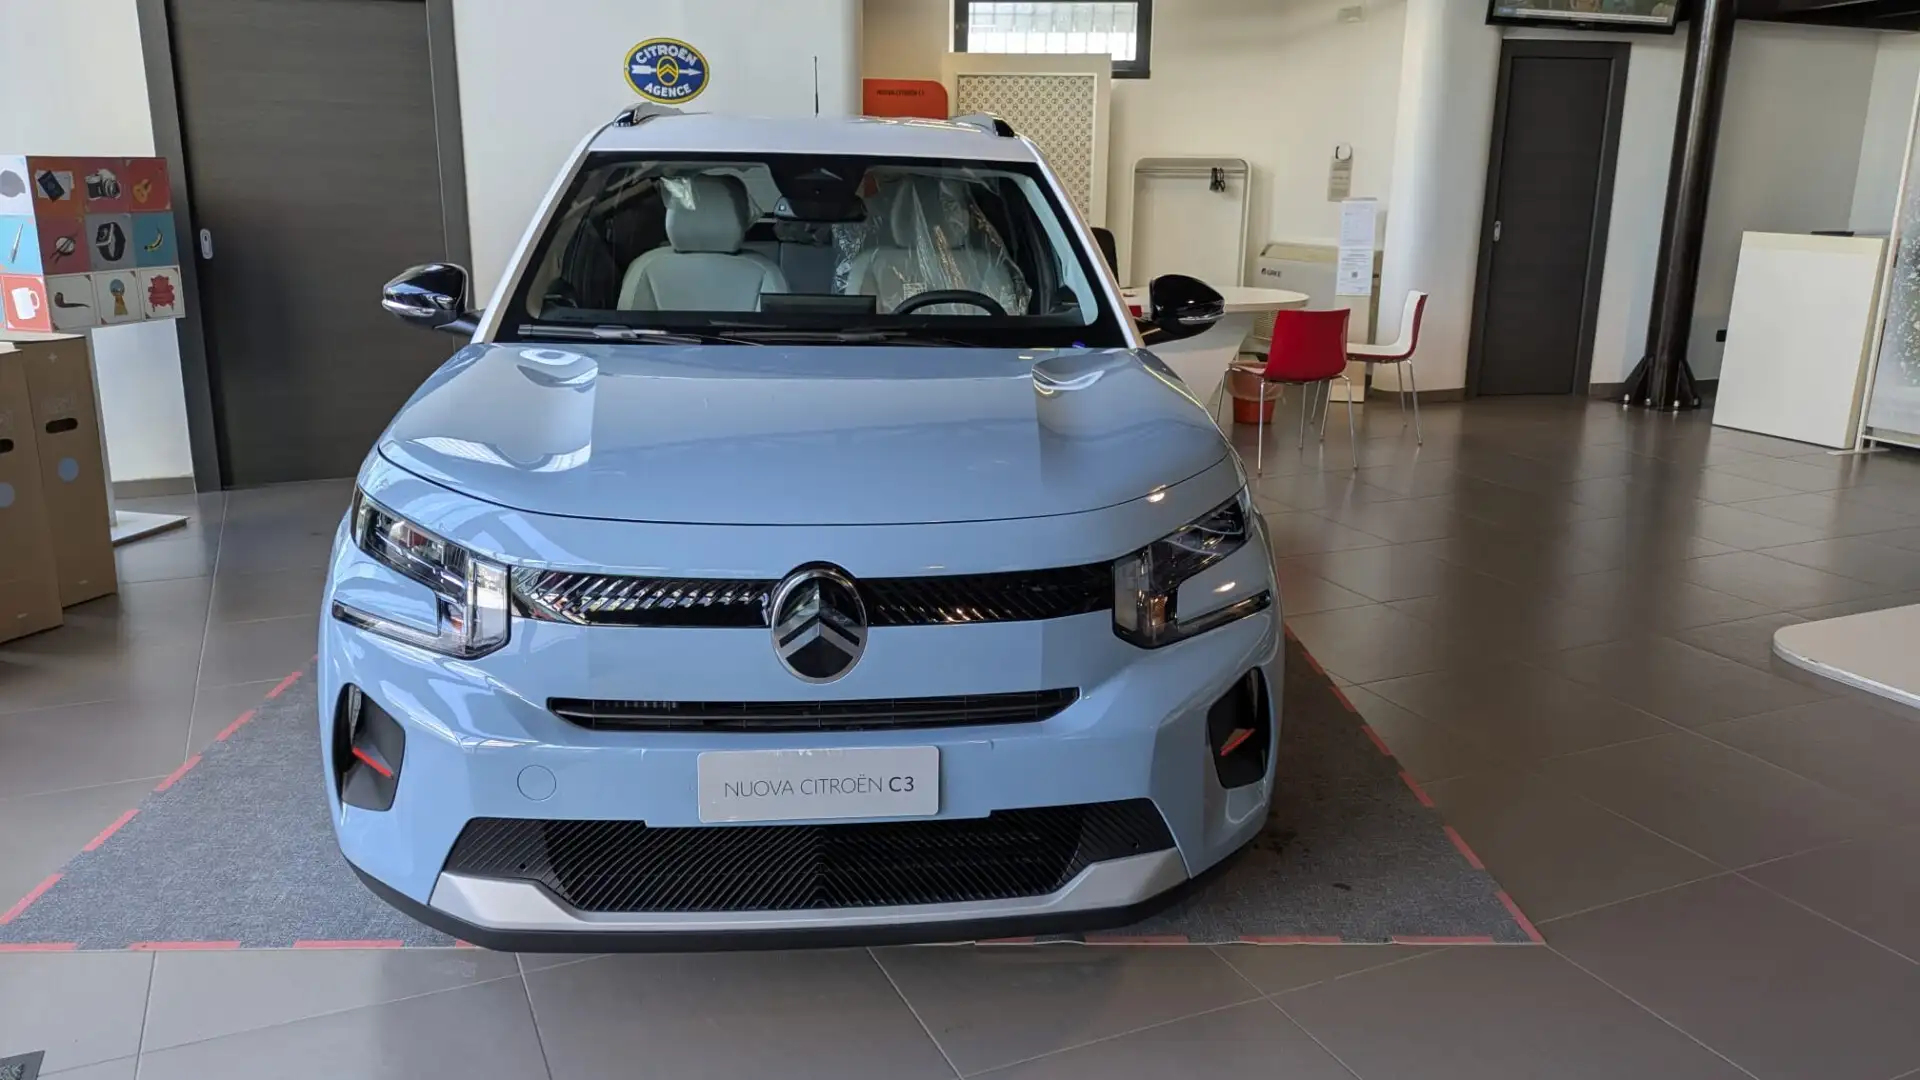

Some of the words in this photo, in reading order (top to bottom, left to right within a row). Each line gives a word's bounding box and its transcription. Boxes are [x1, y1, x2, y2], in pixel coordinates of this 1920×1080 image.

[644, 82, 692, 97] AGENCE
[724, 779, 795, 798] NUOVA
[800, 773, 883, 796] CITROËN
[888, 776, 915, 793] C3
